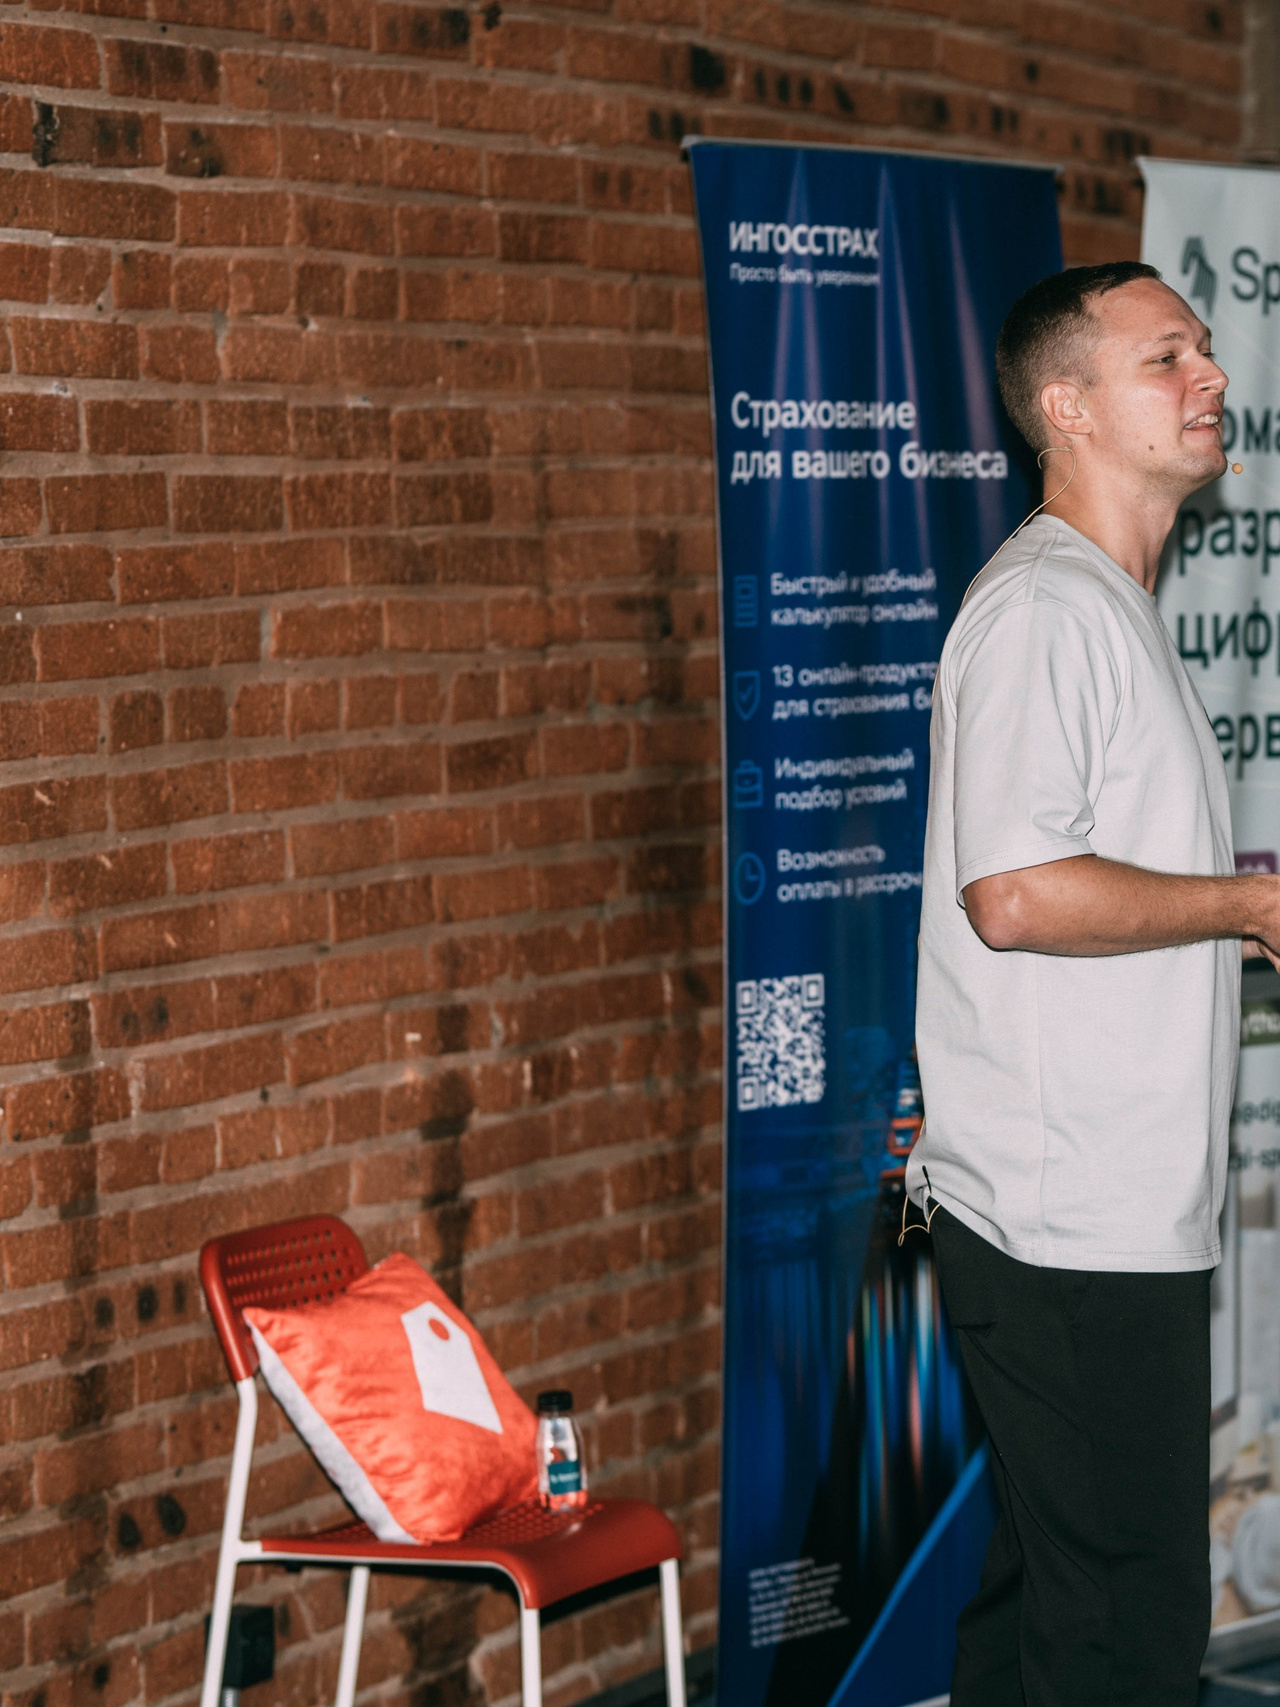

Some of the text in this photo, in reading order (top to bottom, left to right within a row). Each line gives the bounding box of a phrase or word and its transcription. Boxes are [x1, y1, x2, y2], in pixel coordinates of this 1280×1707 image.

[729, 221, 880, 258] ИНГОССТРАХ
[729, 262, 776, 285] Просто
[731, 391, 917, 438] Страхование
[731, 442, 1008, 485] для вашего бизнеса
[770, 571, 847, 598] Быстрый
[862, 568, 937, 597] удобный
[871, 599, 938, 623] онлайн
[772, 661, 938, 687] 13 онлайн-продукто
[772, 700, 809, 720] для
[775, 785, 843, 811] подбор
[855, 872, 923, 899] рассроч
